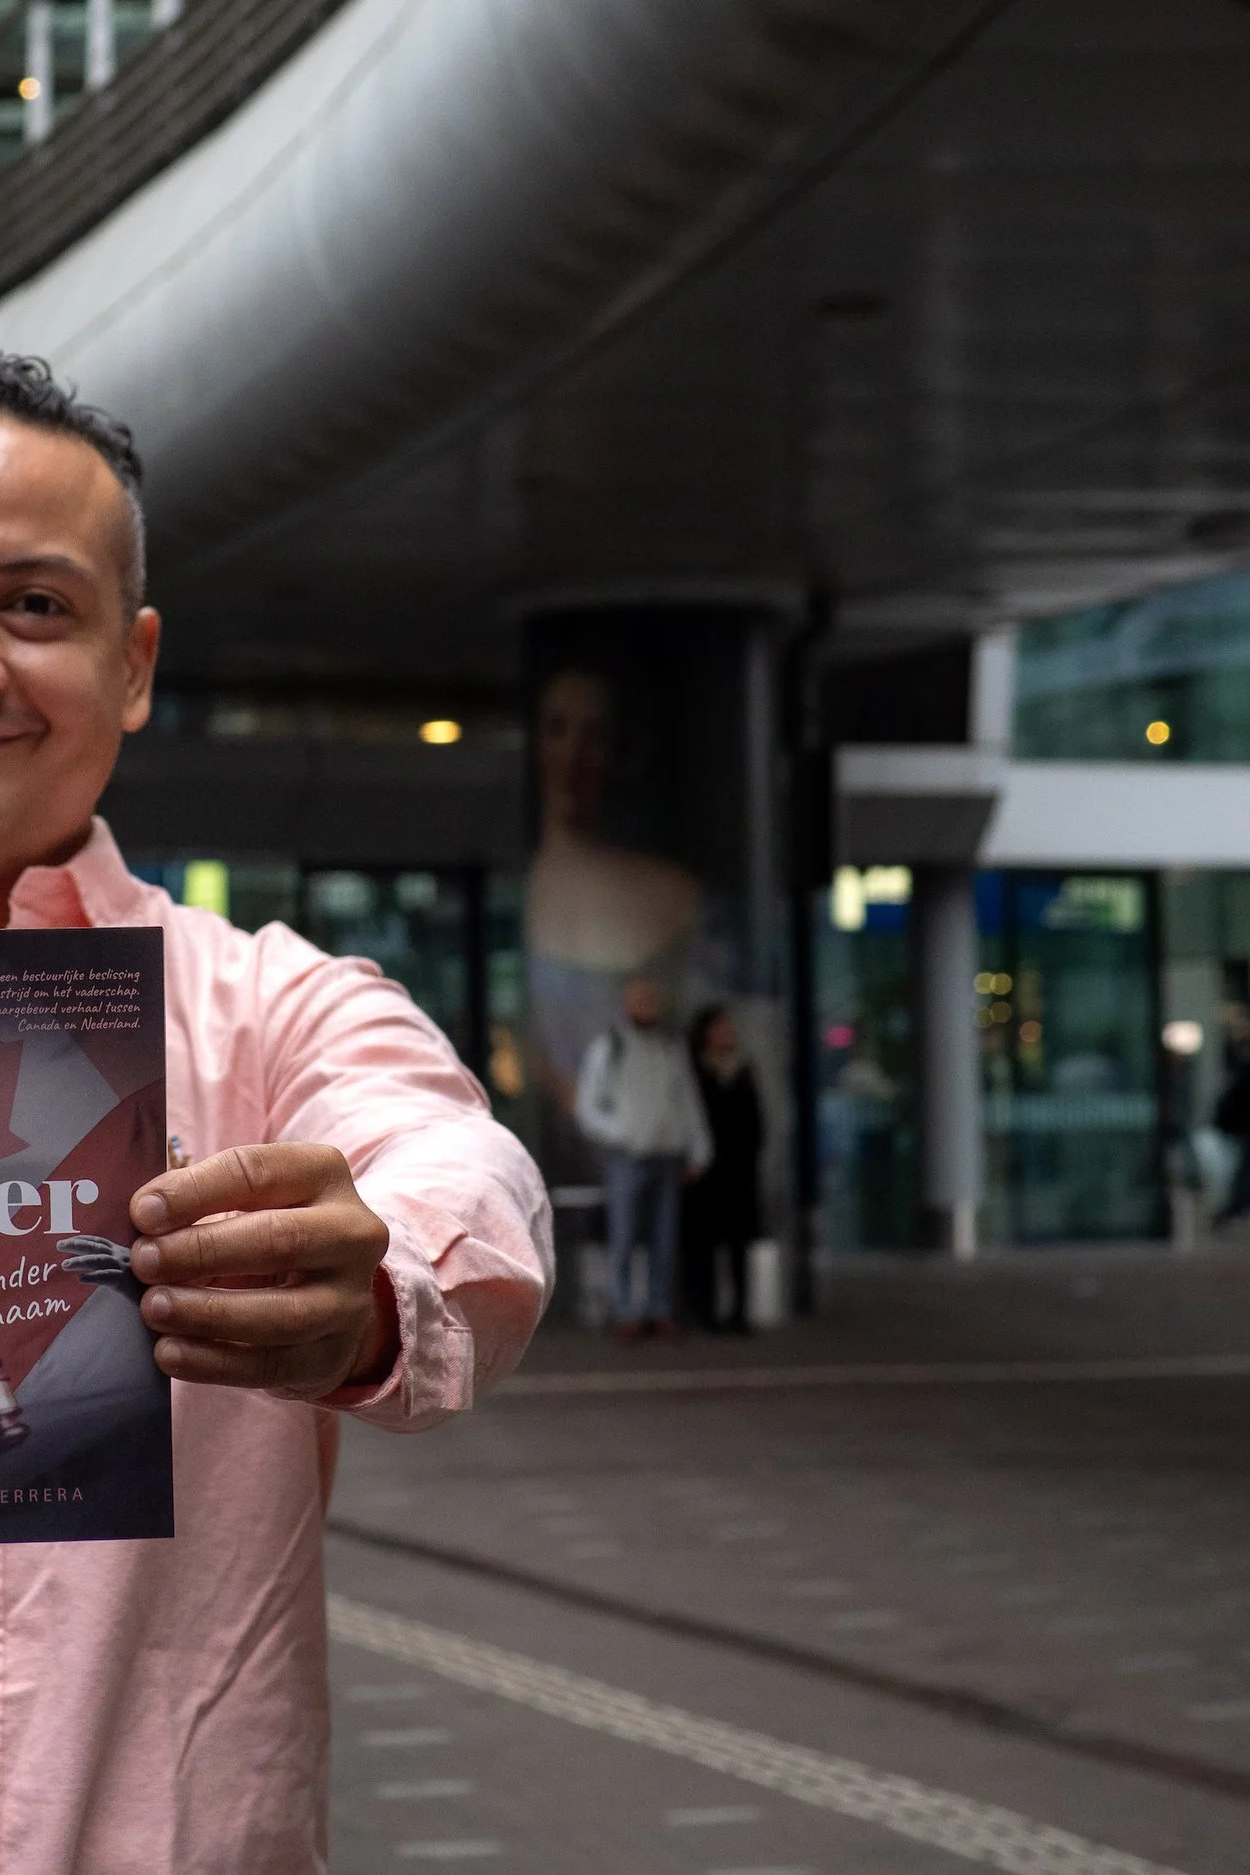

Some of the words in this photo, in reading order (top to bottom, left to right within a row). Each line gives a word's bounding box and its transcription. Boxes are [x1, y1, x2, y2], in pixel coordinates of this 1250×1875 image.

[0, 974, 18, 982] een
[22, 969, 84, 984] bestuurlijke
[89, 968, 140, 983] beslissing
[0, 986, 31, 1002] strijd
[33, 990, 49, 998] om
[53, 985, 71, 998] het
[75, 984, 140, 999] vaderschap.
[61, 1001, 103, 1014] verhaal
[106, 1001, 140, 1013] tussen
[18, 1018, 60, 1032] Canada
[64, 1022, 77, 1030] en
[81, 1016, 140, 1031] Nederland.
